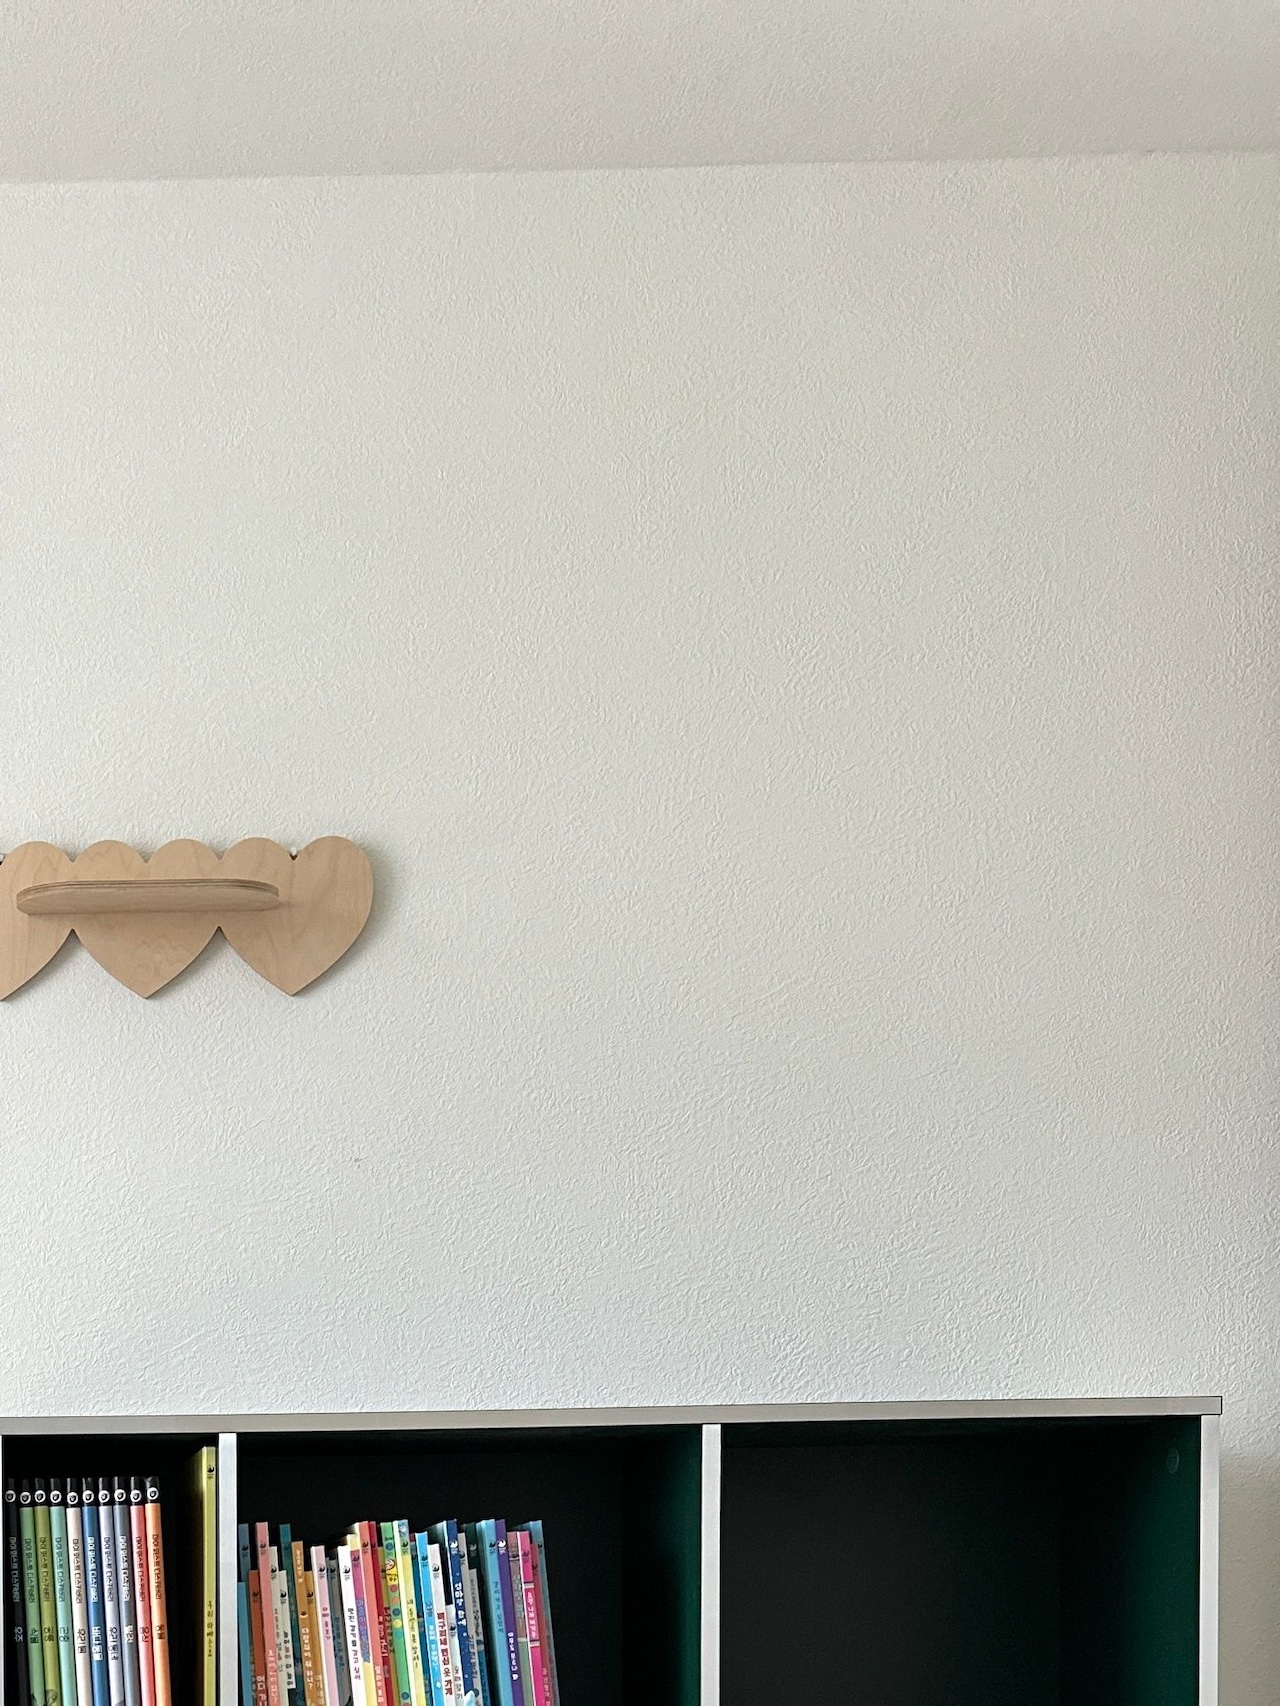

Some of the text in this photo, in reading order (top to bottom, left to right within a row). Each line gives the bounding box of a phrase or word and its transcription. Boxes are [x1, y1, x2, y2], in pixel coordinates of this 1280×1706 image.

[77, 1629, 86, 1644] 우리
[109, 1627, 117, 1644] 우리
[256, 1675, 265, 1690] 어디
[305, 1669, 314, 1690] 하니?
